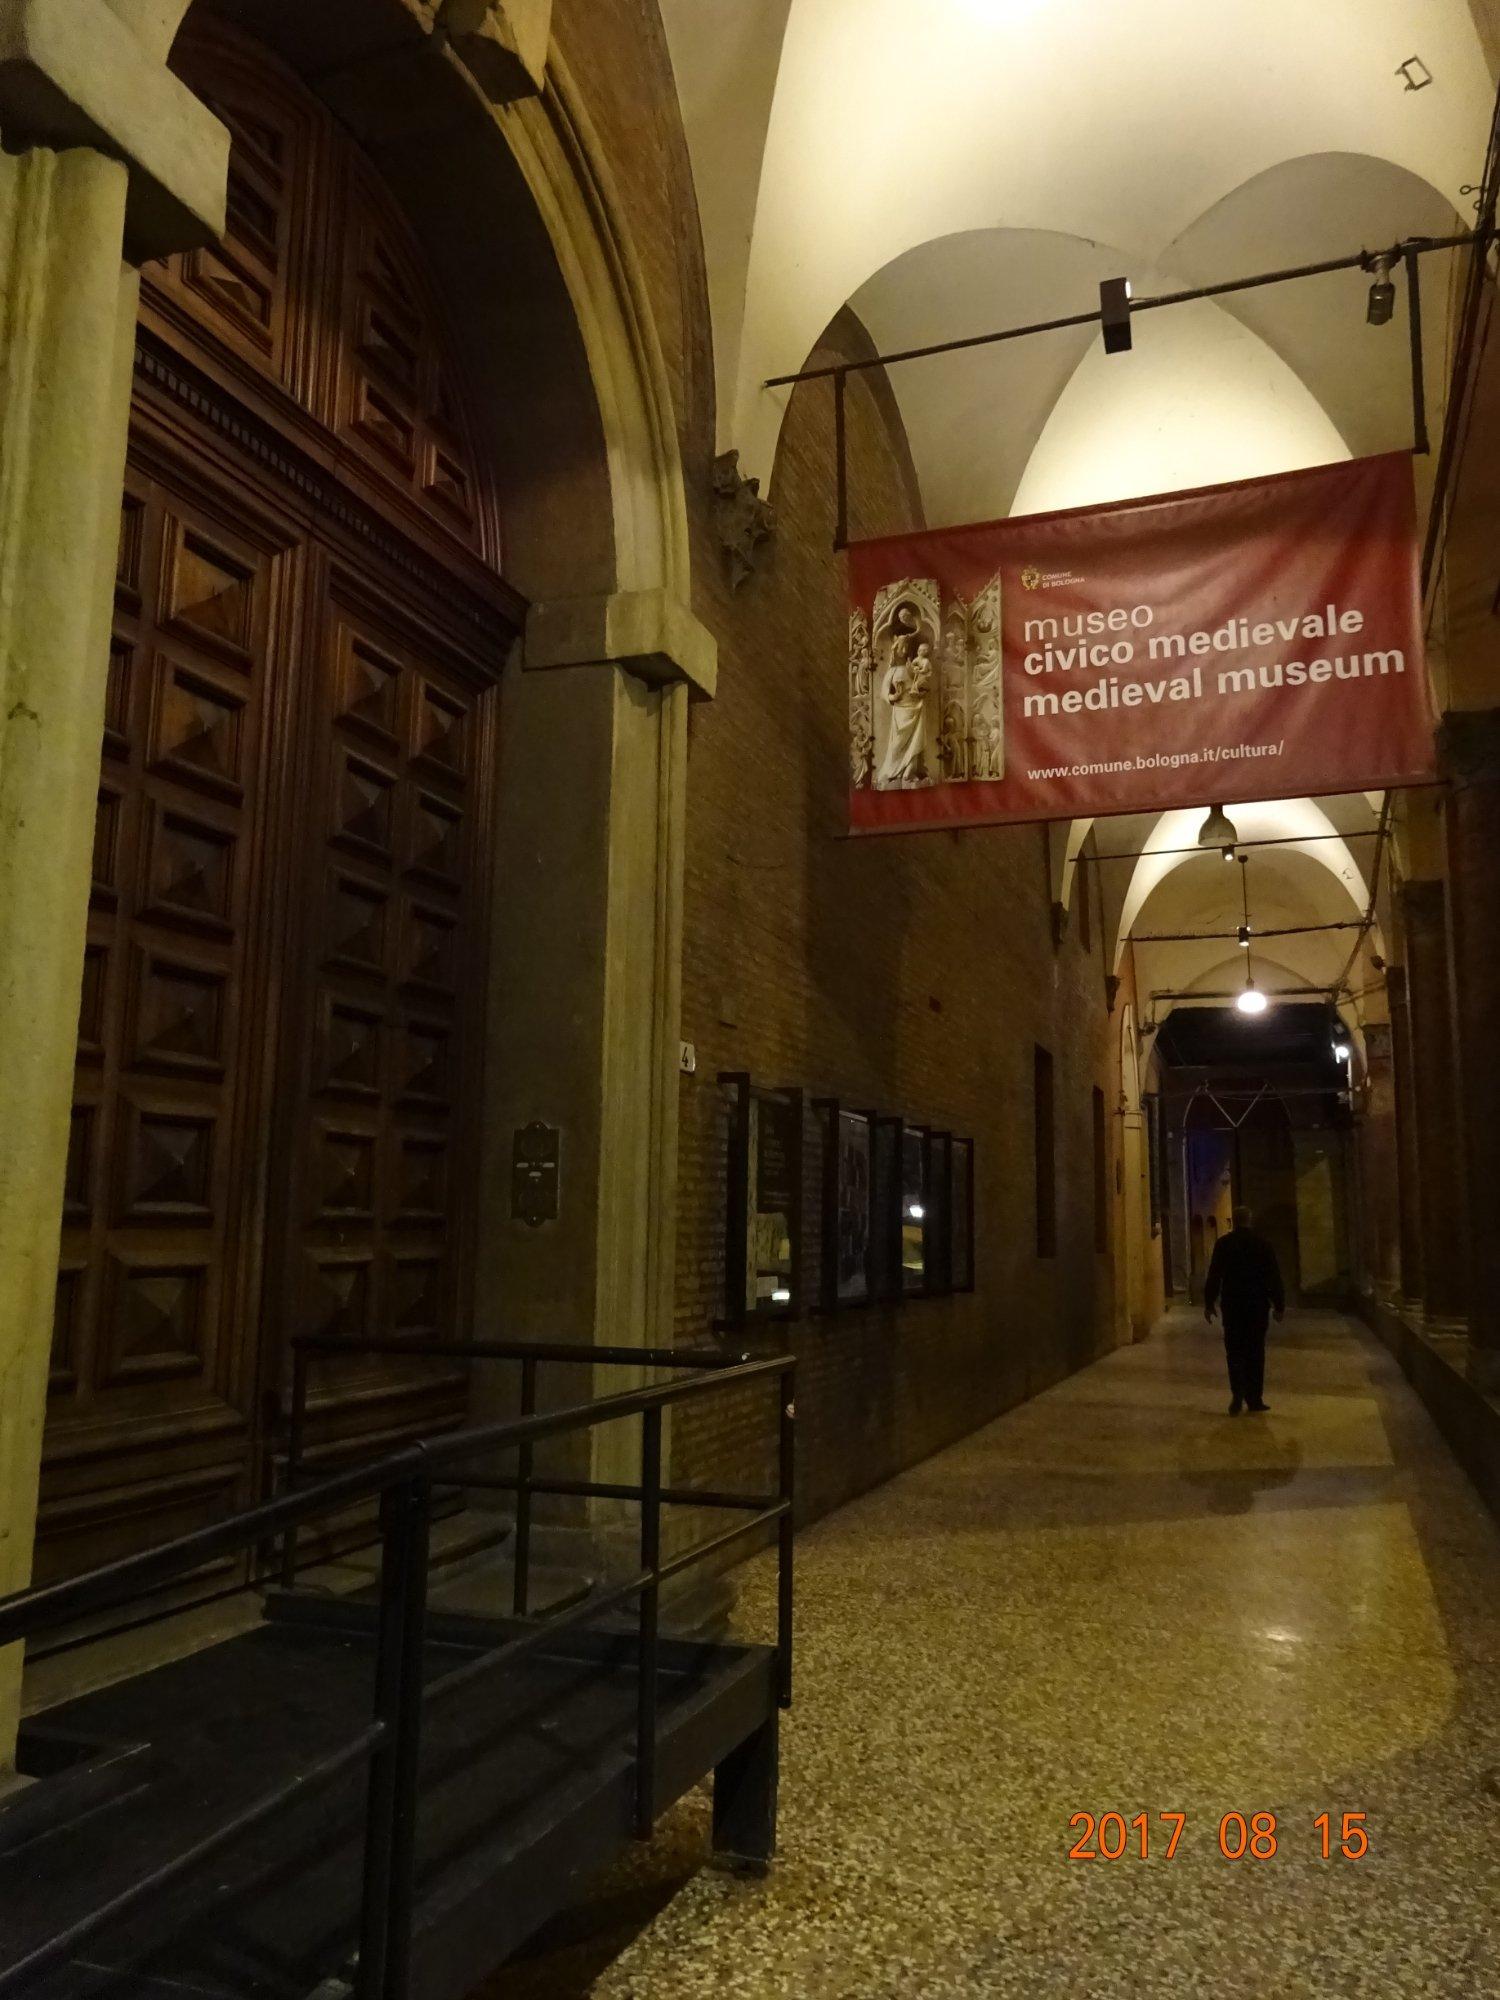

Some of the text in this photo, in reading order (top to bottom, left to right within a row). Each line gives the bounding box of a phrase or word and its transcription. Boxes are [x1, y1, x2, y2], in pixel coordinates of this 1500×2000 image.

[1042, 571, 1071, 581] COMUNE
[1051, 577, 1086, 587] BOLOGNA
[1024, 605, 1154, 642] museo
[1024, 604, 1364, 676] civico medievale
[1024, 649, 1405, 717] medieval museum
[1027, 740, 1284, 780] www.comune.bologna.it/cultura/
[681, 1046, 689, 1068] 4
